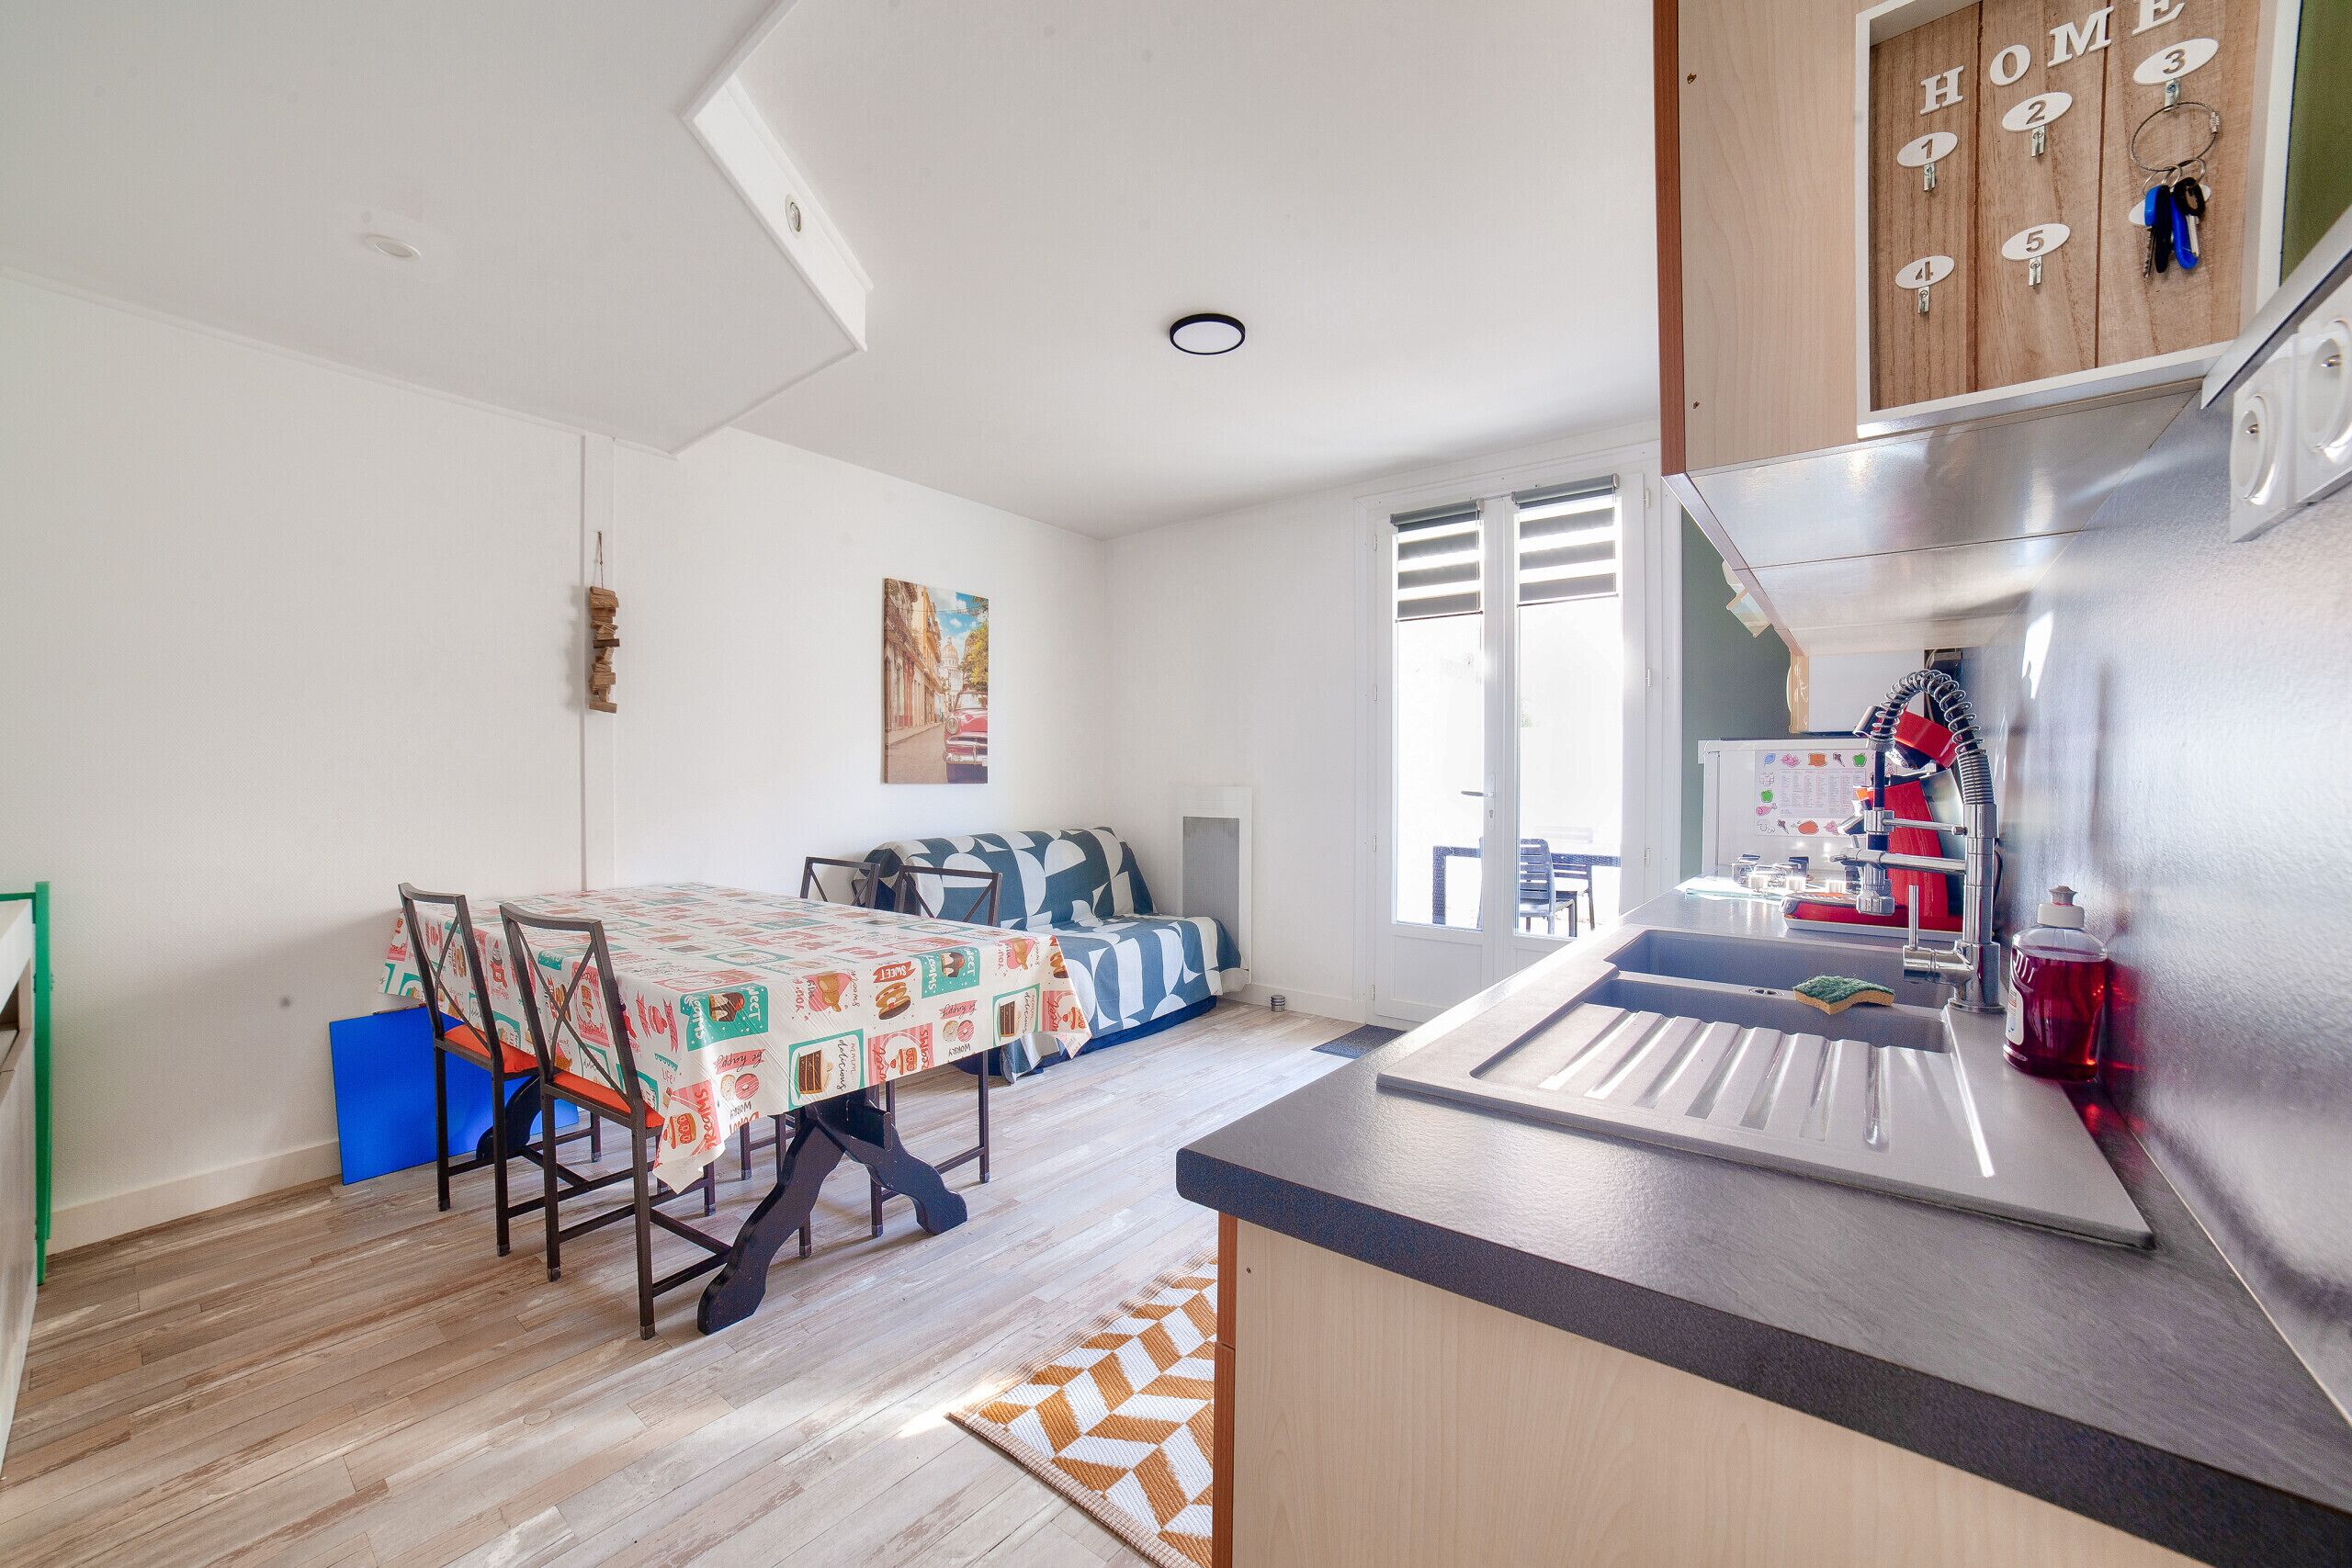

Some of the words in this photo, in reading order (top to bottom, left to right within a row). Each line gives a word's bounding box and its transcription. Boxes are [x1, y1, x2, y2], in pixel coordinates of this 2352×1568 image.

[1919, 0, 2186, 115] HOME
[2163, 49, 2186, 75] 3
[2026, 100, 2046, 126] 2
[1920, 138, 1934, 158] 1
[2026, 231, 2044, 253] 5
[1915, 260, 1934, 281] 4
[879, 965, 907, 979] SWEET
[943, 1004, 966, 1019] happy
[948, 1043, 970, 1056] WORRY
[752, 1052, 762, 1068] be
[837, 1040, 848, 1091] delicious
[729, 1101, 752, 1120] WORRY
